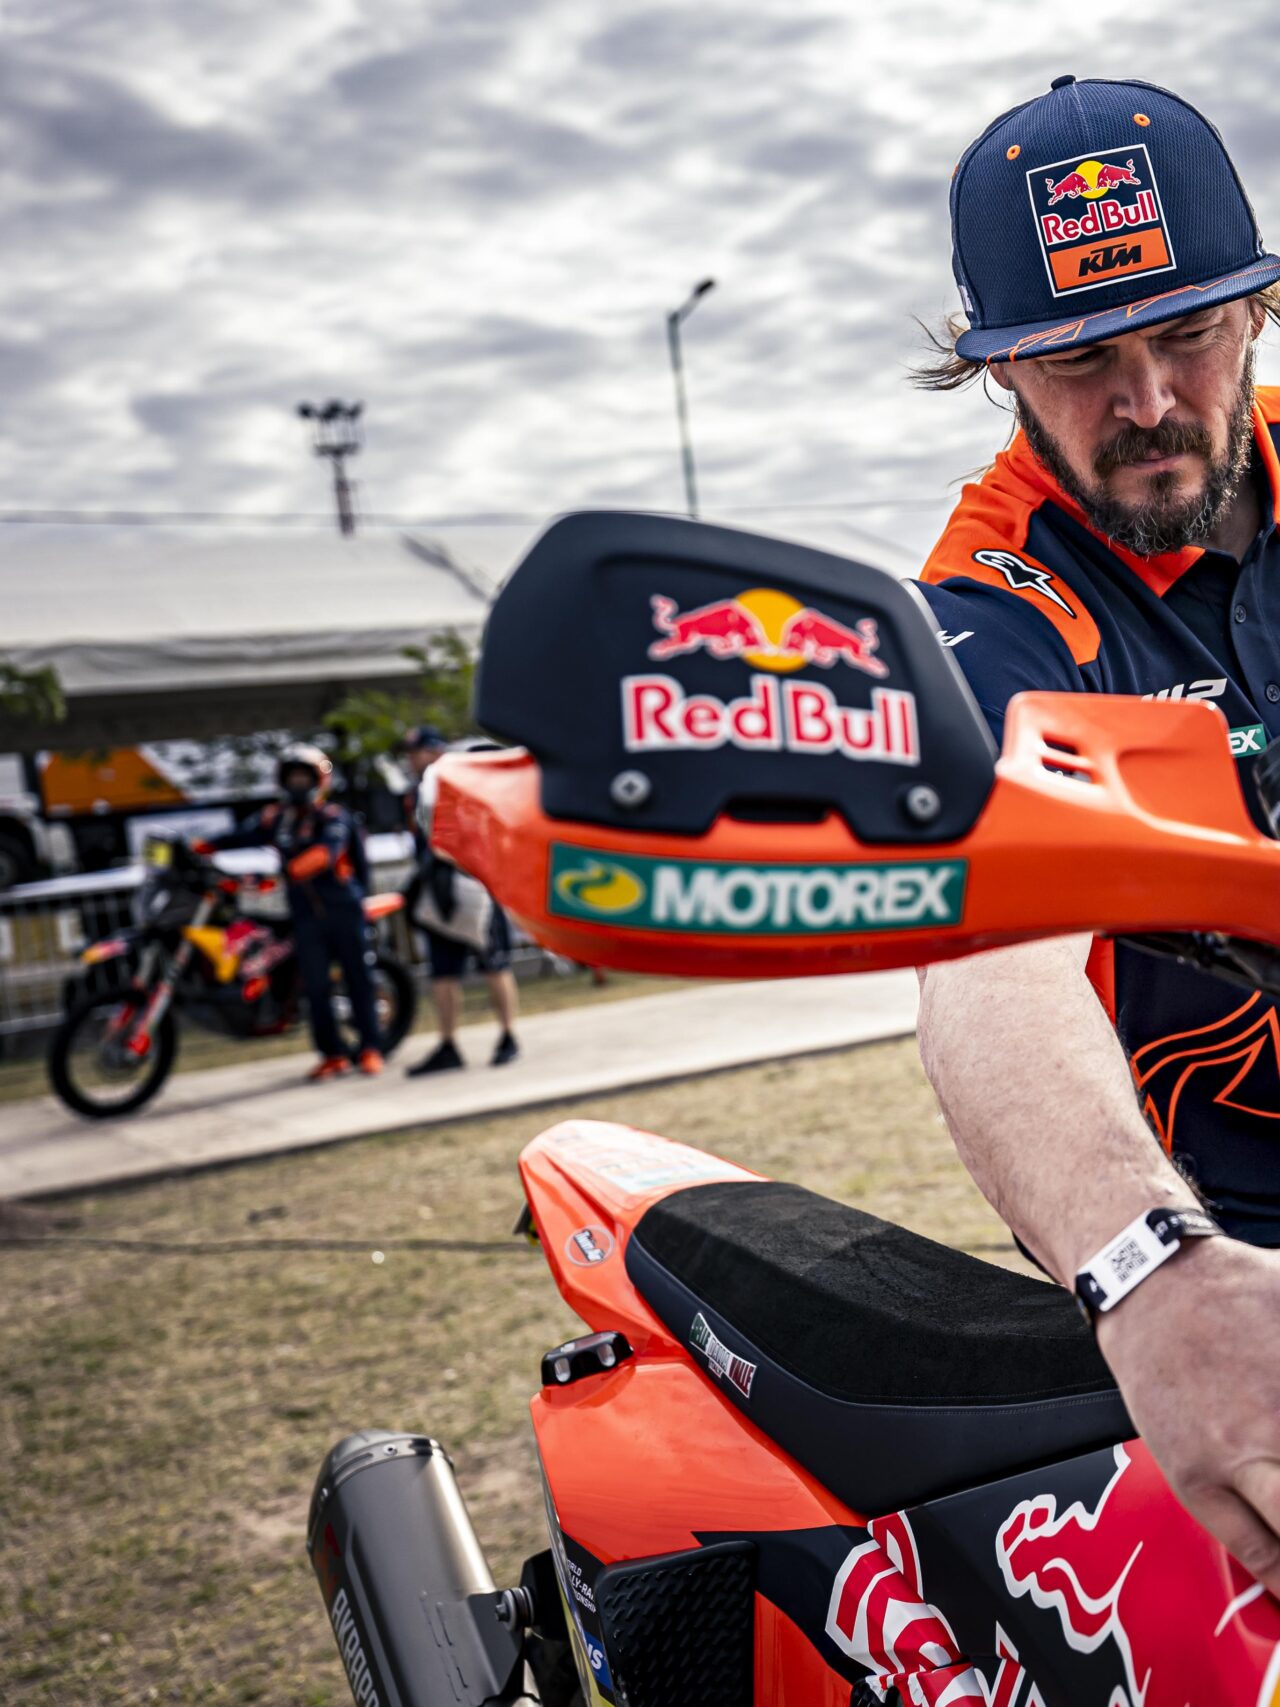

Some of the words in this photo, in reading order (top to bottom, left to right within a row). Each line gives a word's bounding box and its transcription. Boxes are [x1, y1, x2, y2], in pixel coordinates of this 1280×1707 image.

[1040, 201, 1103, 246] Red
[1099, 189, 1159, 232] Bull
[1078, 243, 1142, 277] KTM
[621, 673, 782, 753] Red
[780, 678, 921, 767] Bull
[651, 866, 960, 927] MOTOREX
